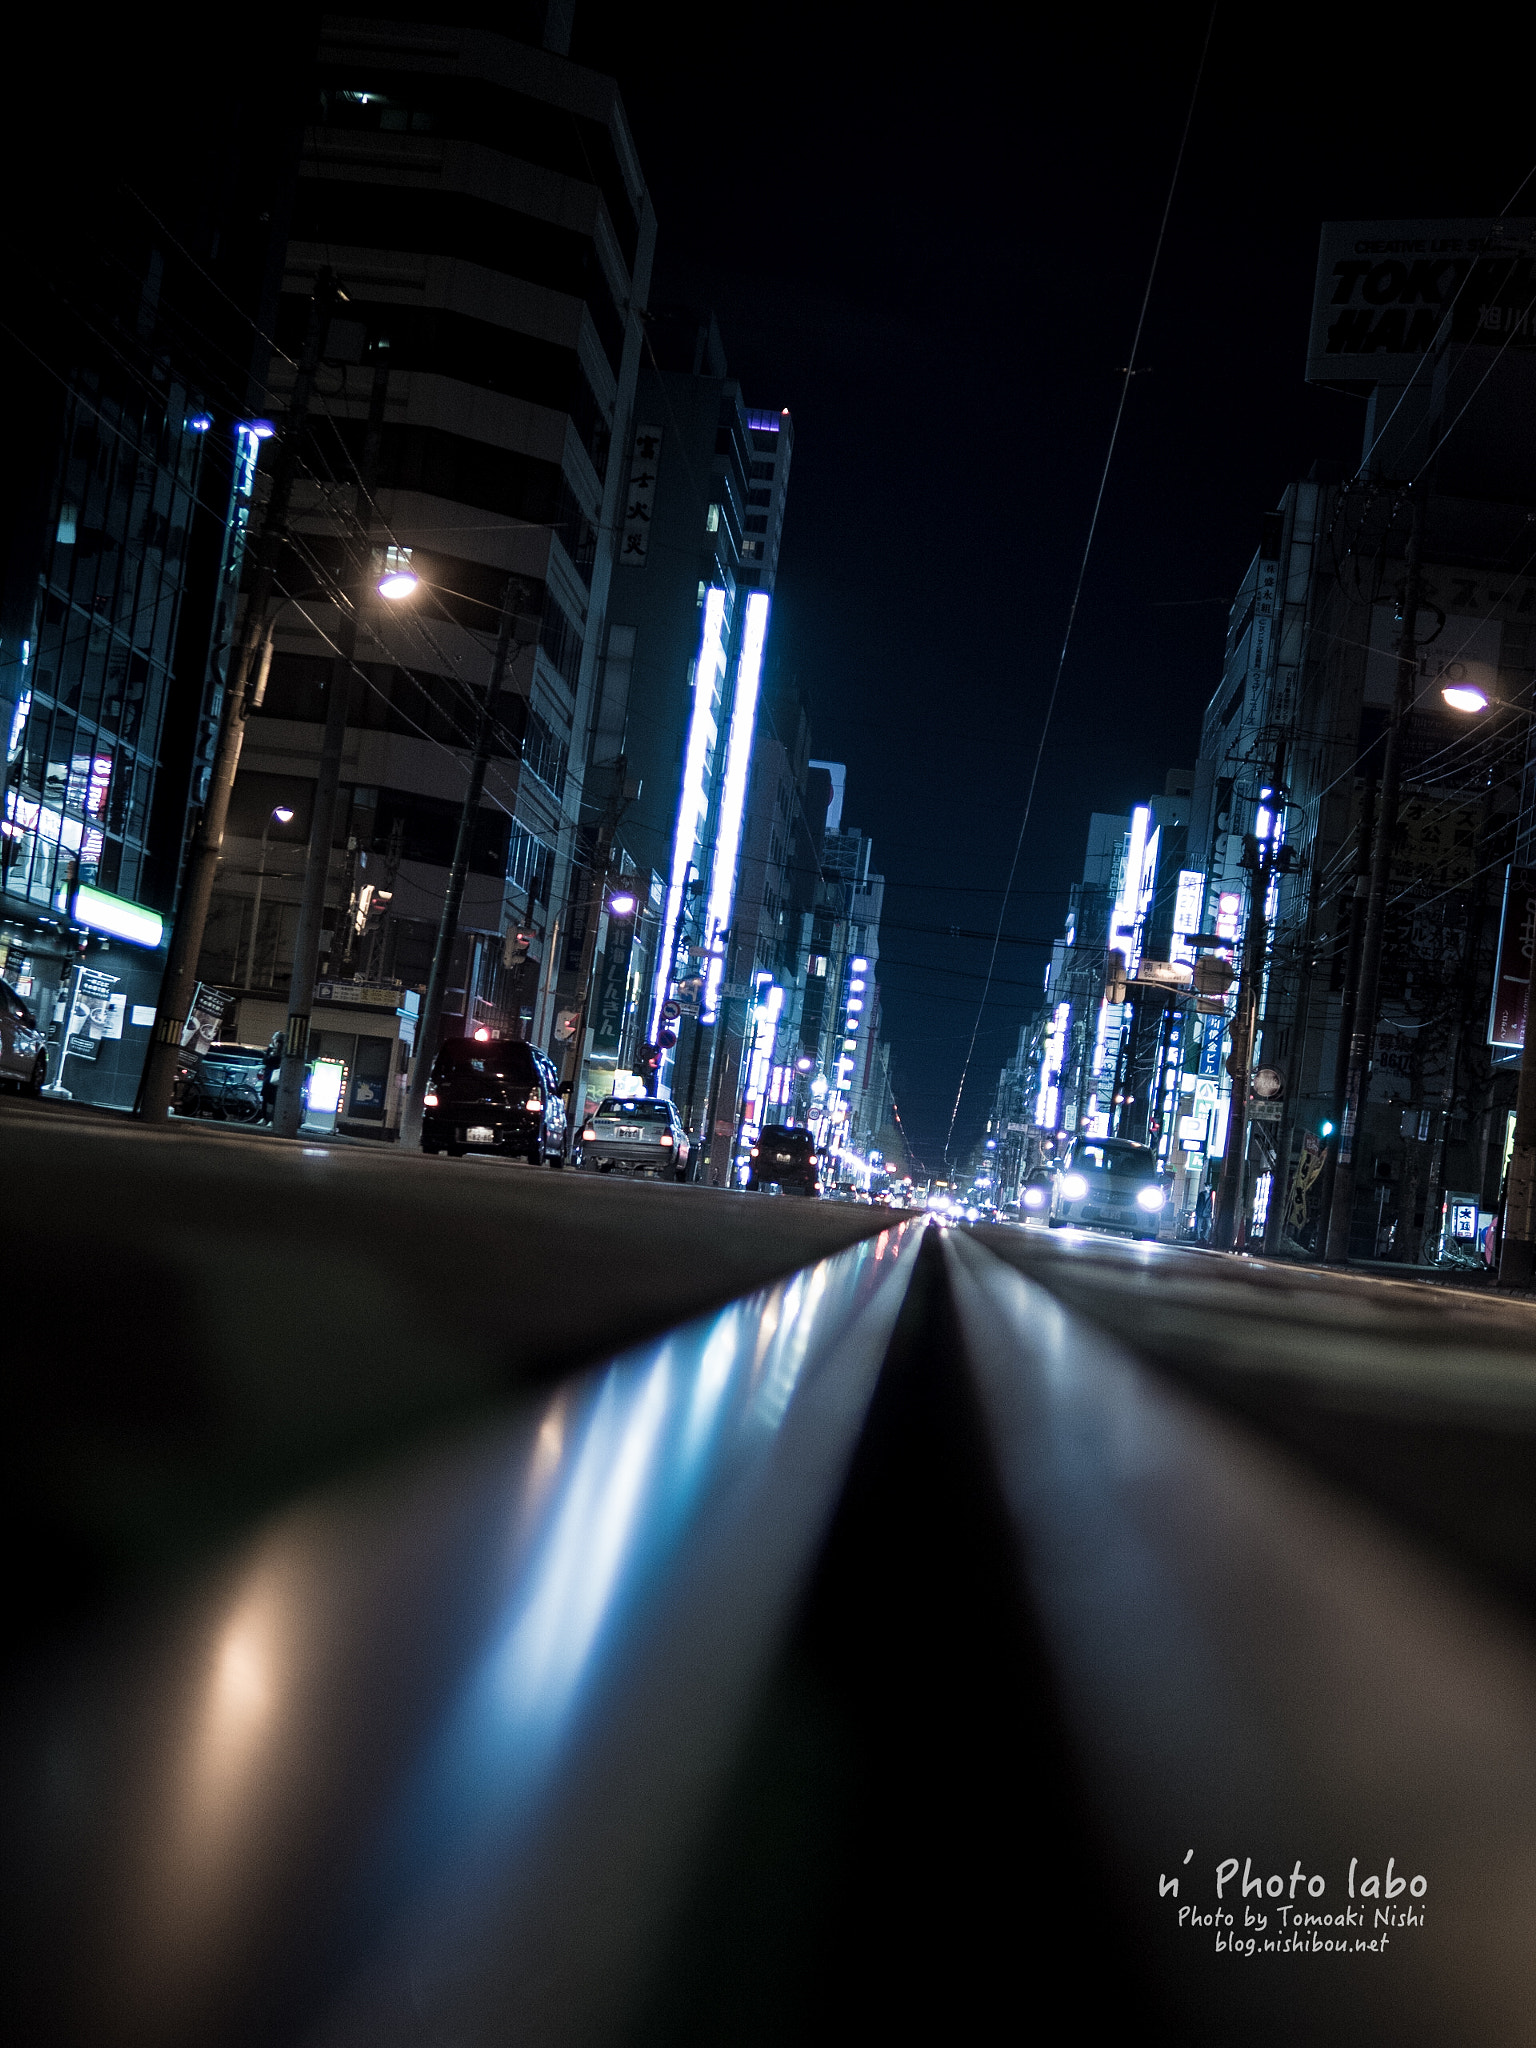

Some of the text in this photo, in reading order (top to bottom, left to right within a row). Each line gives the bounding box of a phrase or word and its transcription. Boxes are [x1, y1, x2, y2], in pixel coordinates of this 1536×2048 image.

[1354, 239, 1426, 254] CREATIVE
[623, 435, 660, 557] 富士火災
[599, 930, 628, 1037] 北海しんきん
